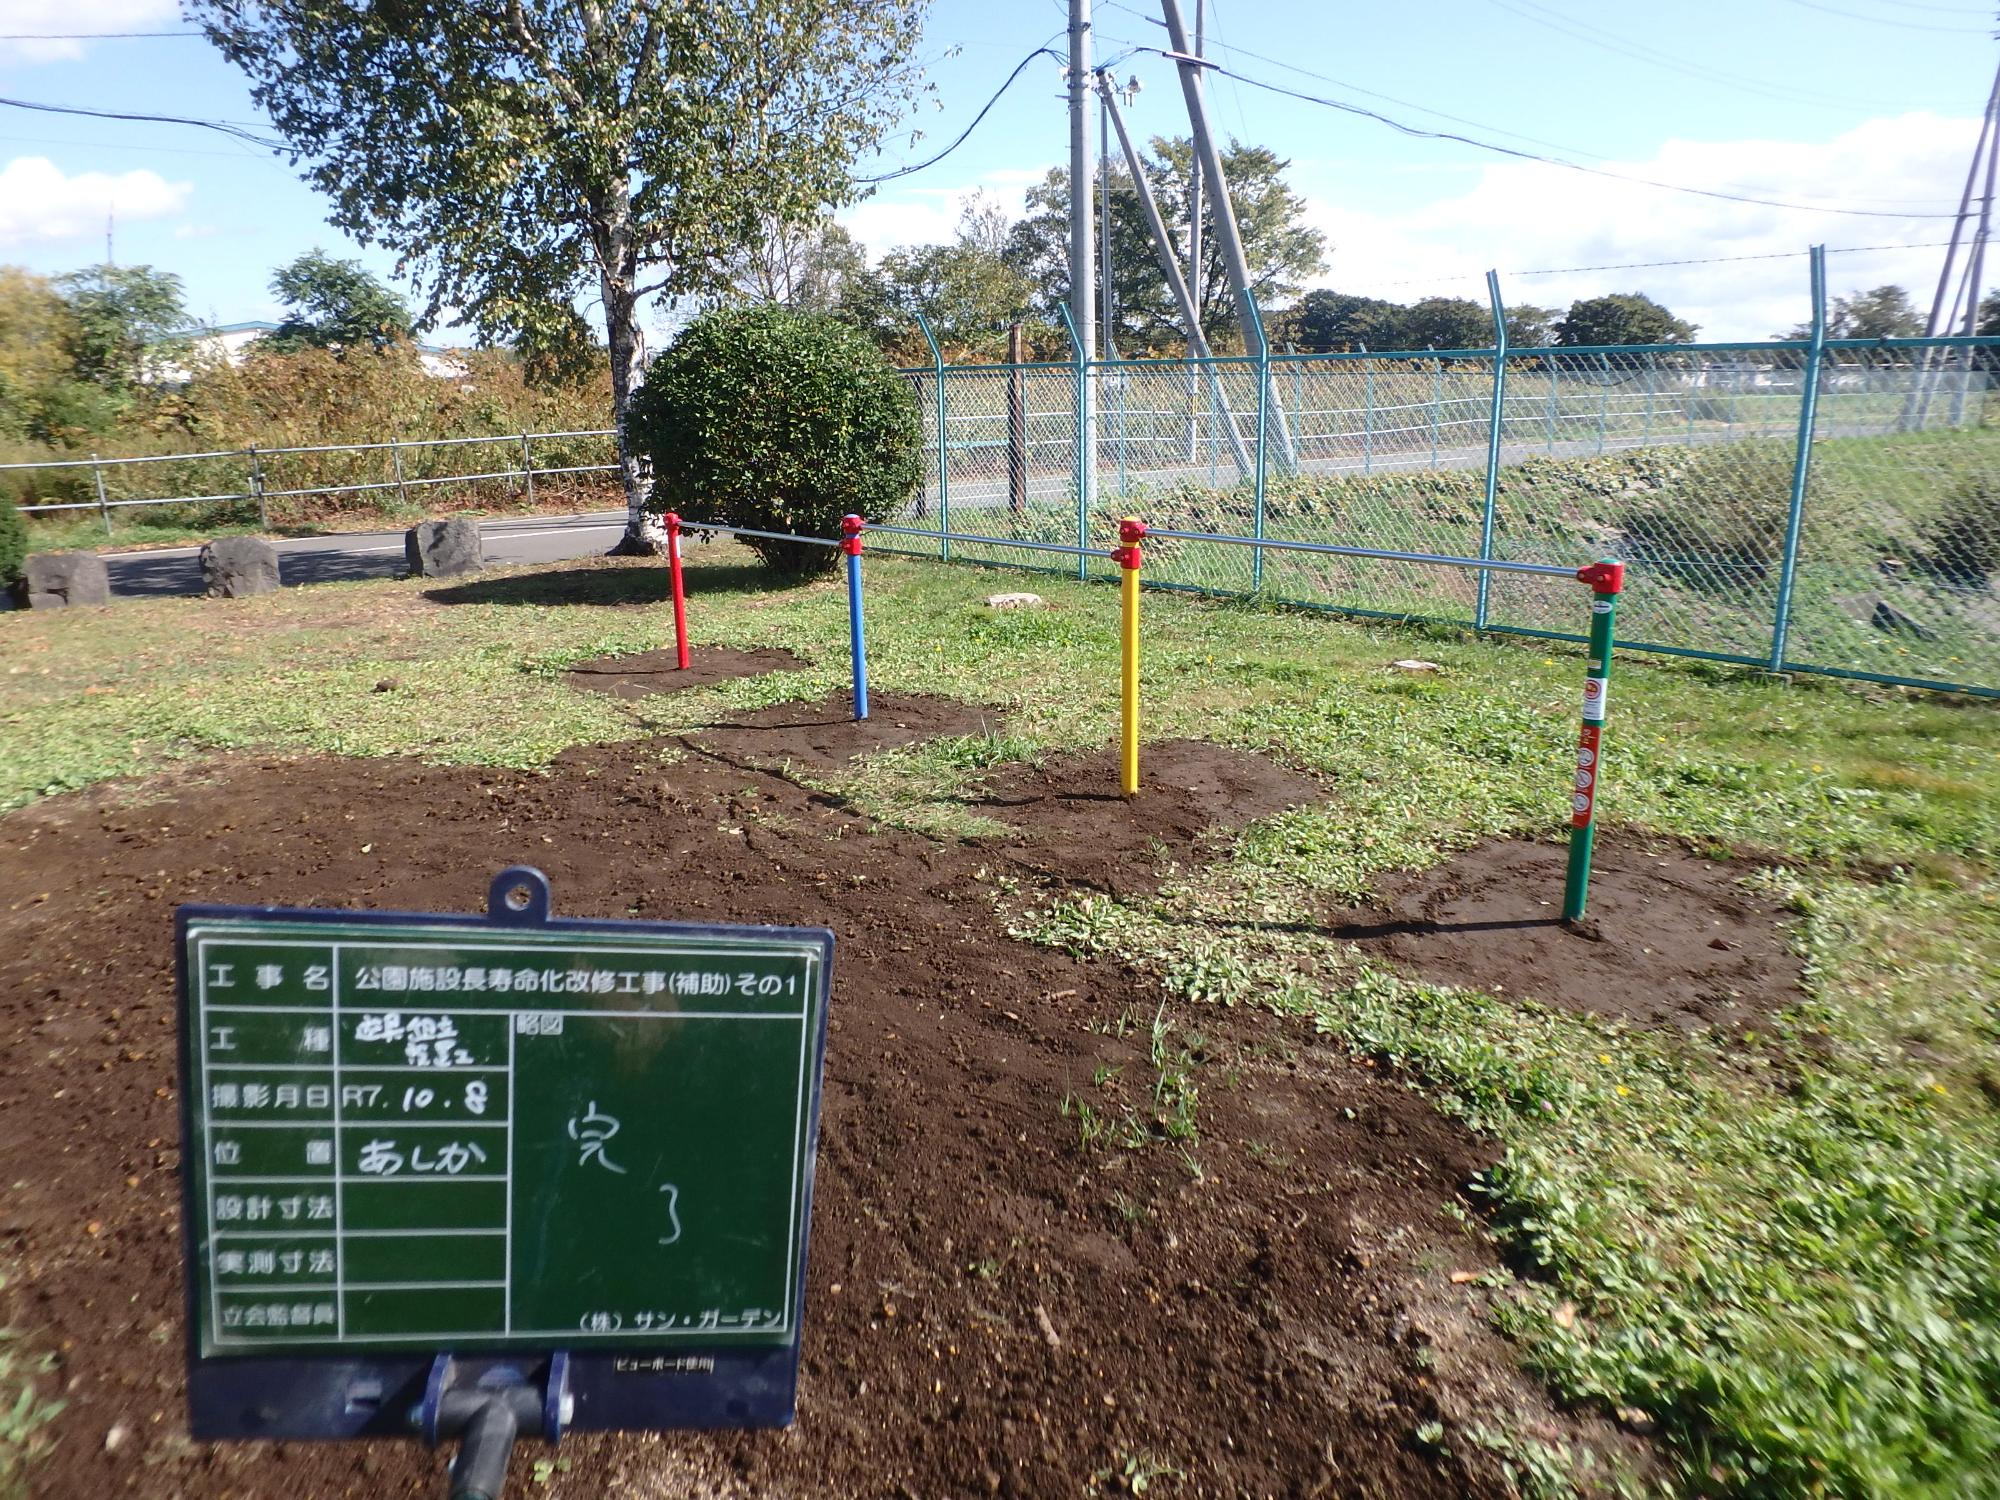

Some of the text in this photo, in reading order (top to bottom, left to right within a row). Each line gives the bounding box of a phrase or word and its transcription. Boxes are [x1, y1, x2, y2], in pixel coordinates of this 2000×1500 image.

[208, 963, 330, 990] 工事名
[355, 965, 796, 996] 公園施設長寿命化改修工事(補助)その1
[210, 1026, 330, 1051] 工種
[212, 1083, 330, 1109] 撮影月日
[214, 1140, 332, 1164] 位置
[358, 1138, 487, 1176] あしか
[216, 1195, 334, 1221] 設計寸法
[217, 1250, 335, 1275] 実測寸法
[223, 1303, 334, 1326] 立会監督員
